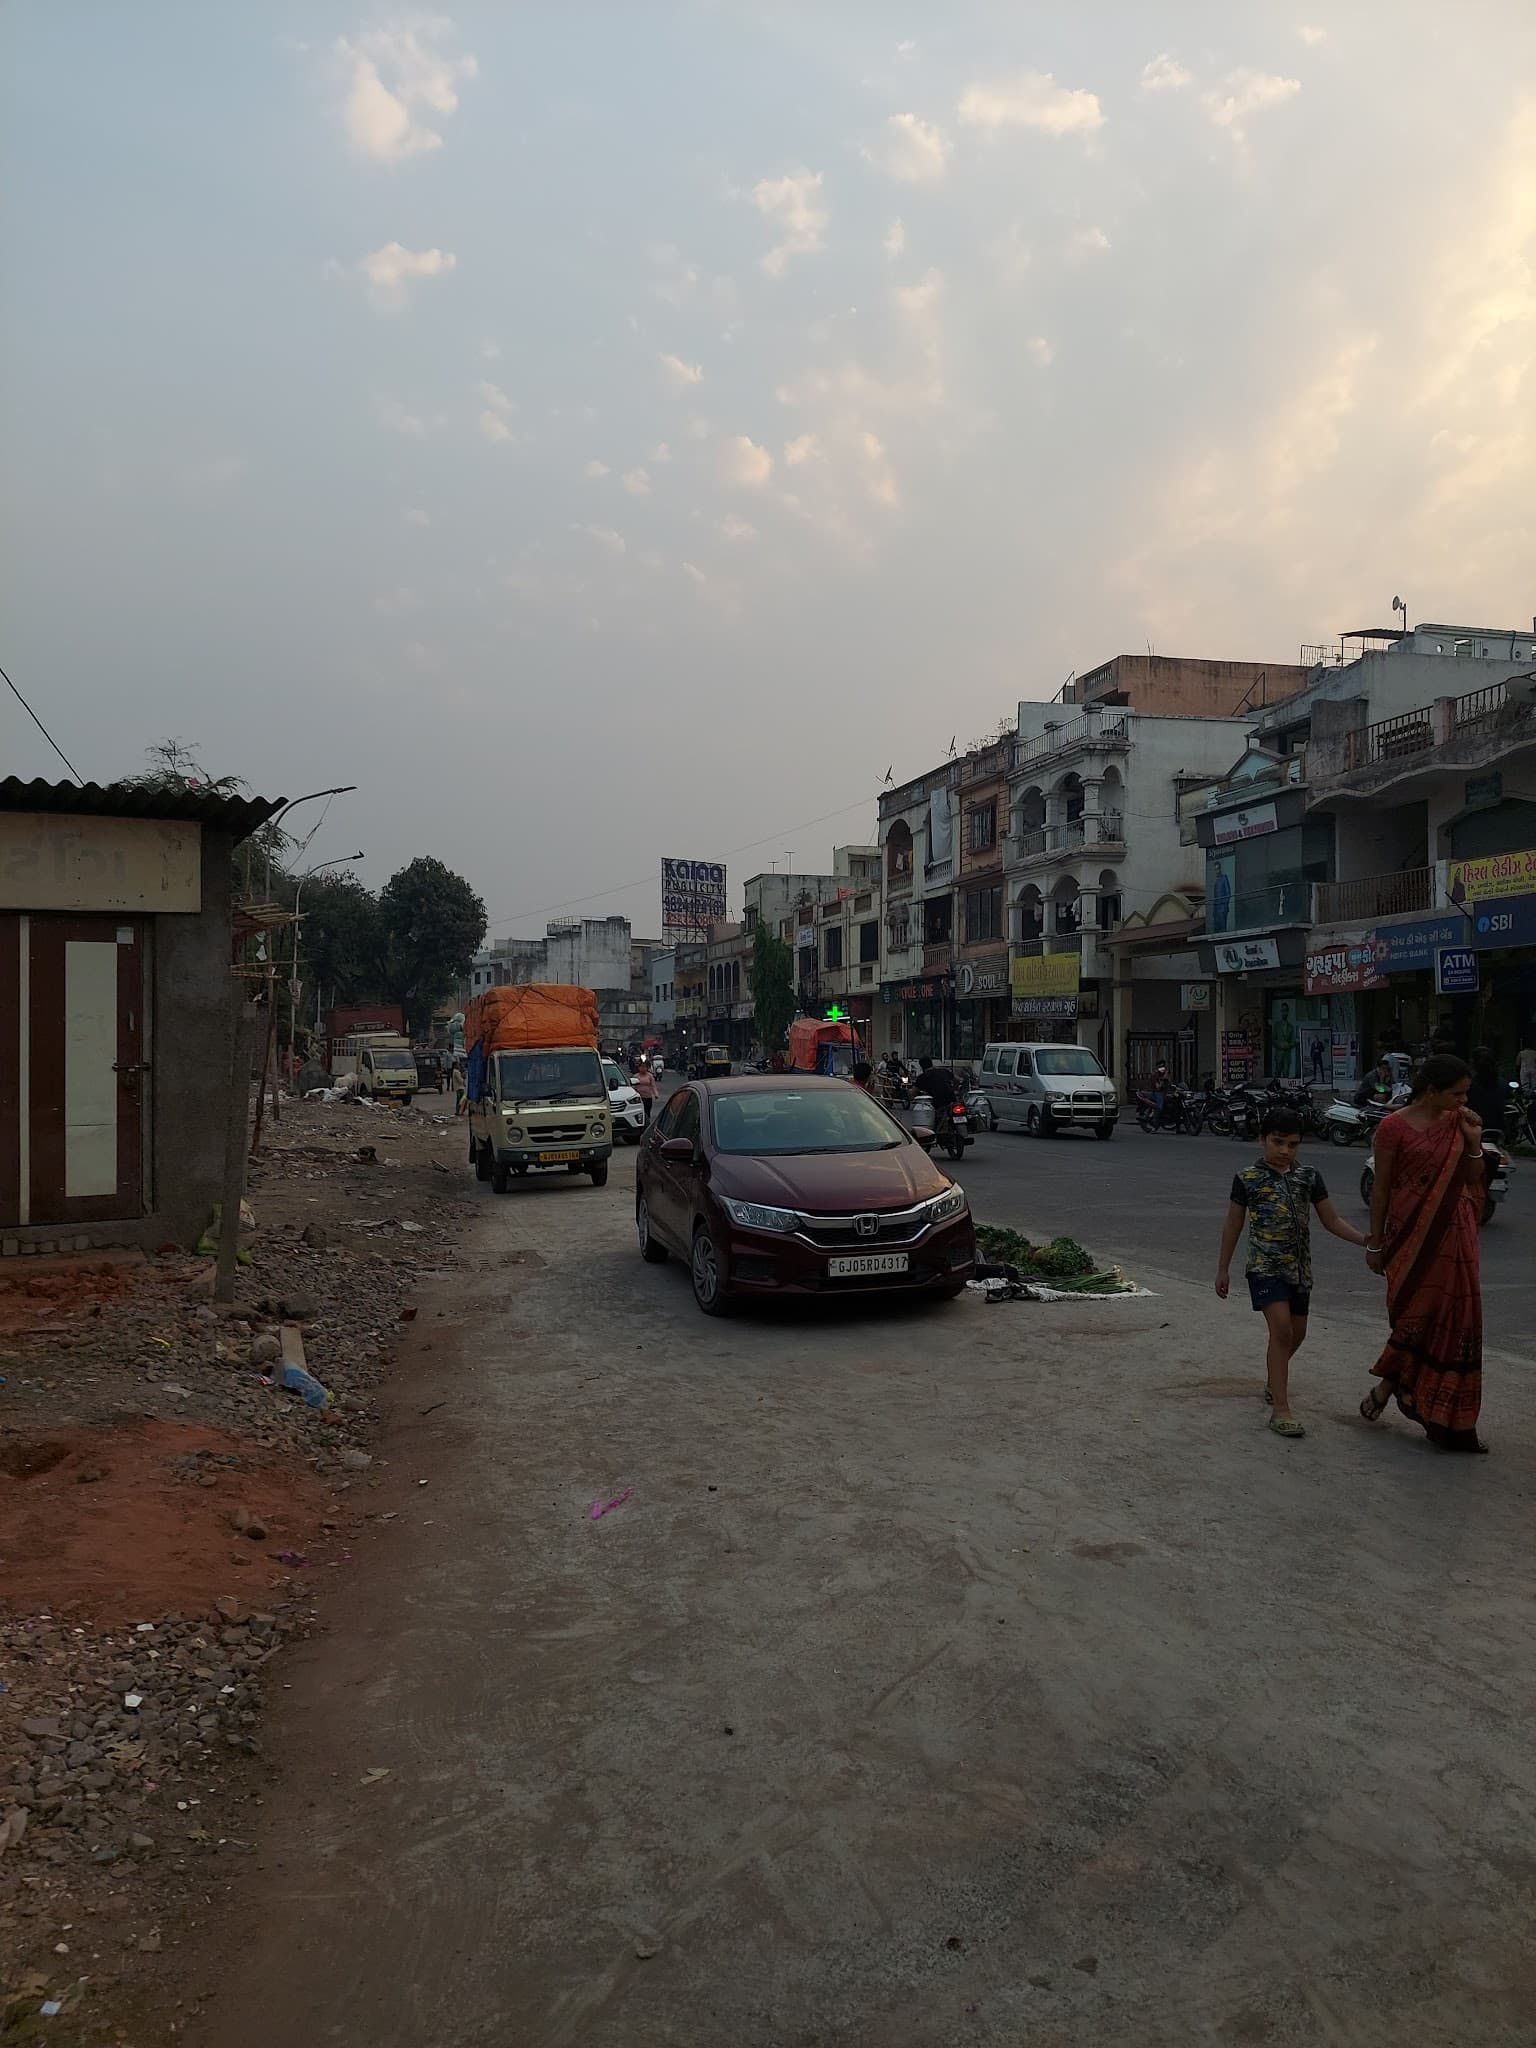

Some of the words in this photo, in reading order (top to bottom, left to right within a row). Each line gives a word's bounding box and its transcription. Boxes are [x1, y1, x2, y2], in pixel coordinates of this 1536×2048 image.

[1463, 862, 1488, 882] હિરલ
[664, 879, 723, 894] PUBLICITY
[1491, 913, 1513, 931] SBI
[1443, 953, 1476, 969] ATM
[838, 1256, 907, 1273] GJ05RD4317
